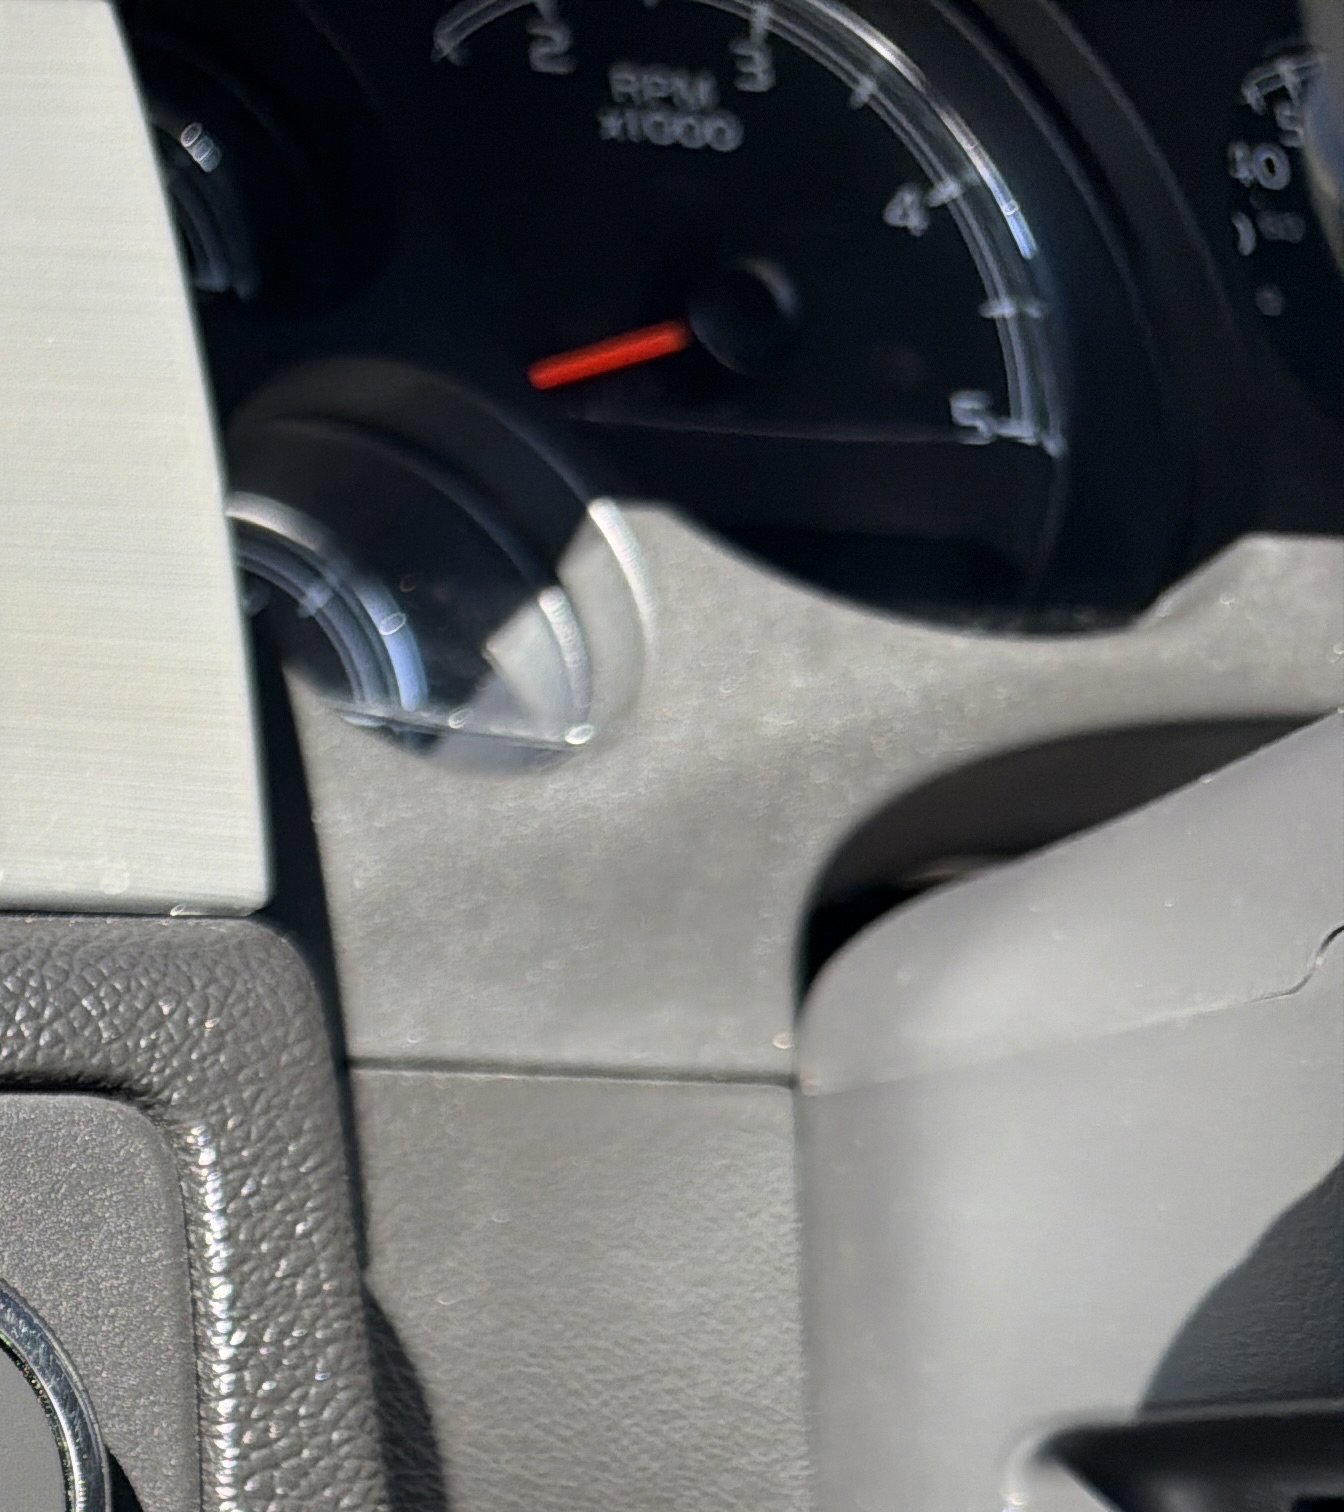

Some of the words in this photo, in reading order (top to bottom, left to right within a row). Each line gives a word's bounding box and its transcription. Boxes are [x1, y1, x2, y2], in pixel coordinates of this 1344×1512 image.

[610, 62, 717, 109] RPM
[729, 38, 776, 92] 3
[882, 183, 928, 237] 4
[949, 390, 996, 444] 5
